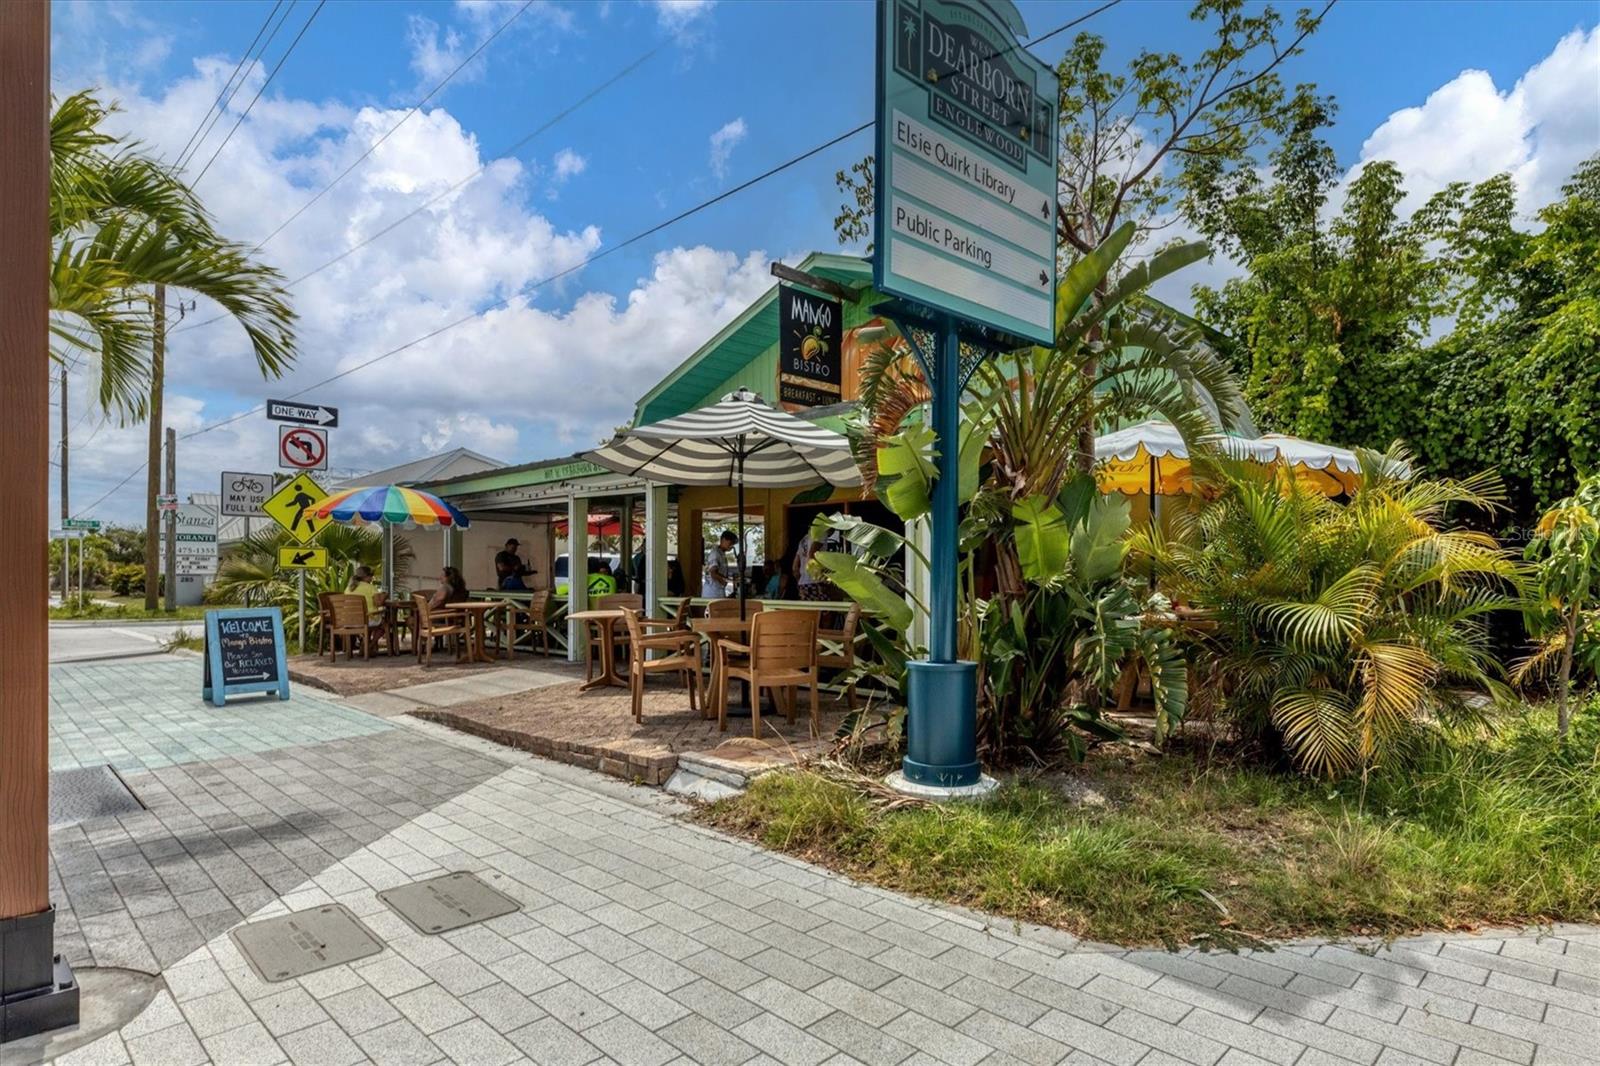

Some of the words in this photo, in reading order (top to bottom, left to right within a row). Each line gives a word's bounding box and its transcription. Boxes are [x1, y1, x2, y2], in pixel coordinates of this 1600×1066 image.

[928, 21, 1030, 118] DEARBORN
[951, 76, 1010, 127] STREET
[936, 98, 1023, 160] ENGLEWOOD
[897, 120, 932, 157] Elsie
[935, 143, 971, 180] Quirk
[974, 163, 1016, 203] Library
[896, 206, 940, 244] Public
[944, 228, 992, 269] Parking
[791, 295, 832, 329] MANGO
[793, 358, 831, 377] BISTRO
[783, 386, 816, 402] BREAKFAST
[274, 407, 295, 416] ONE
[297, 409, 318, 419] WAY
[225, 504, 244, 512] FULL
[229, 494, 246, 503] MAY
[250, 496, 264, 504] USE
[176, 512, 215, 527] Stanza
[220, 620, 272, 634] WELCOME
